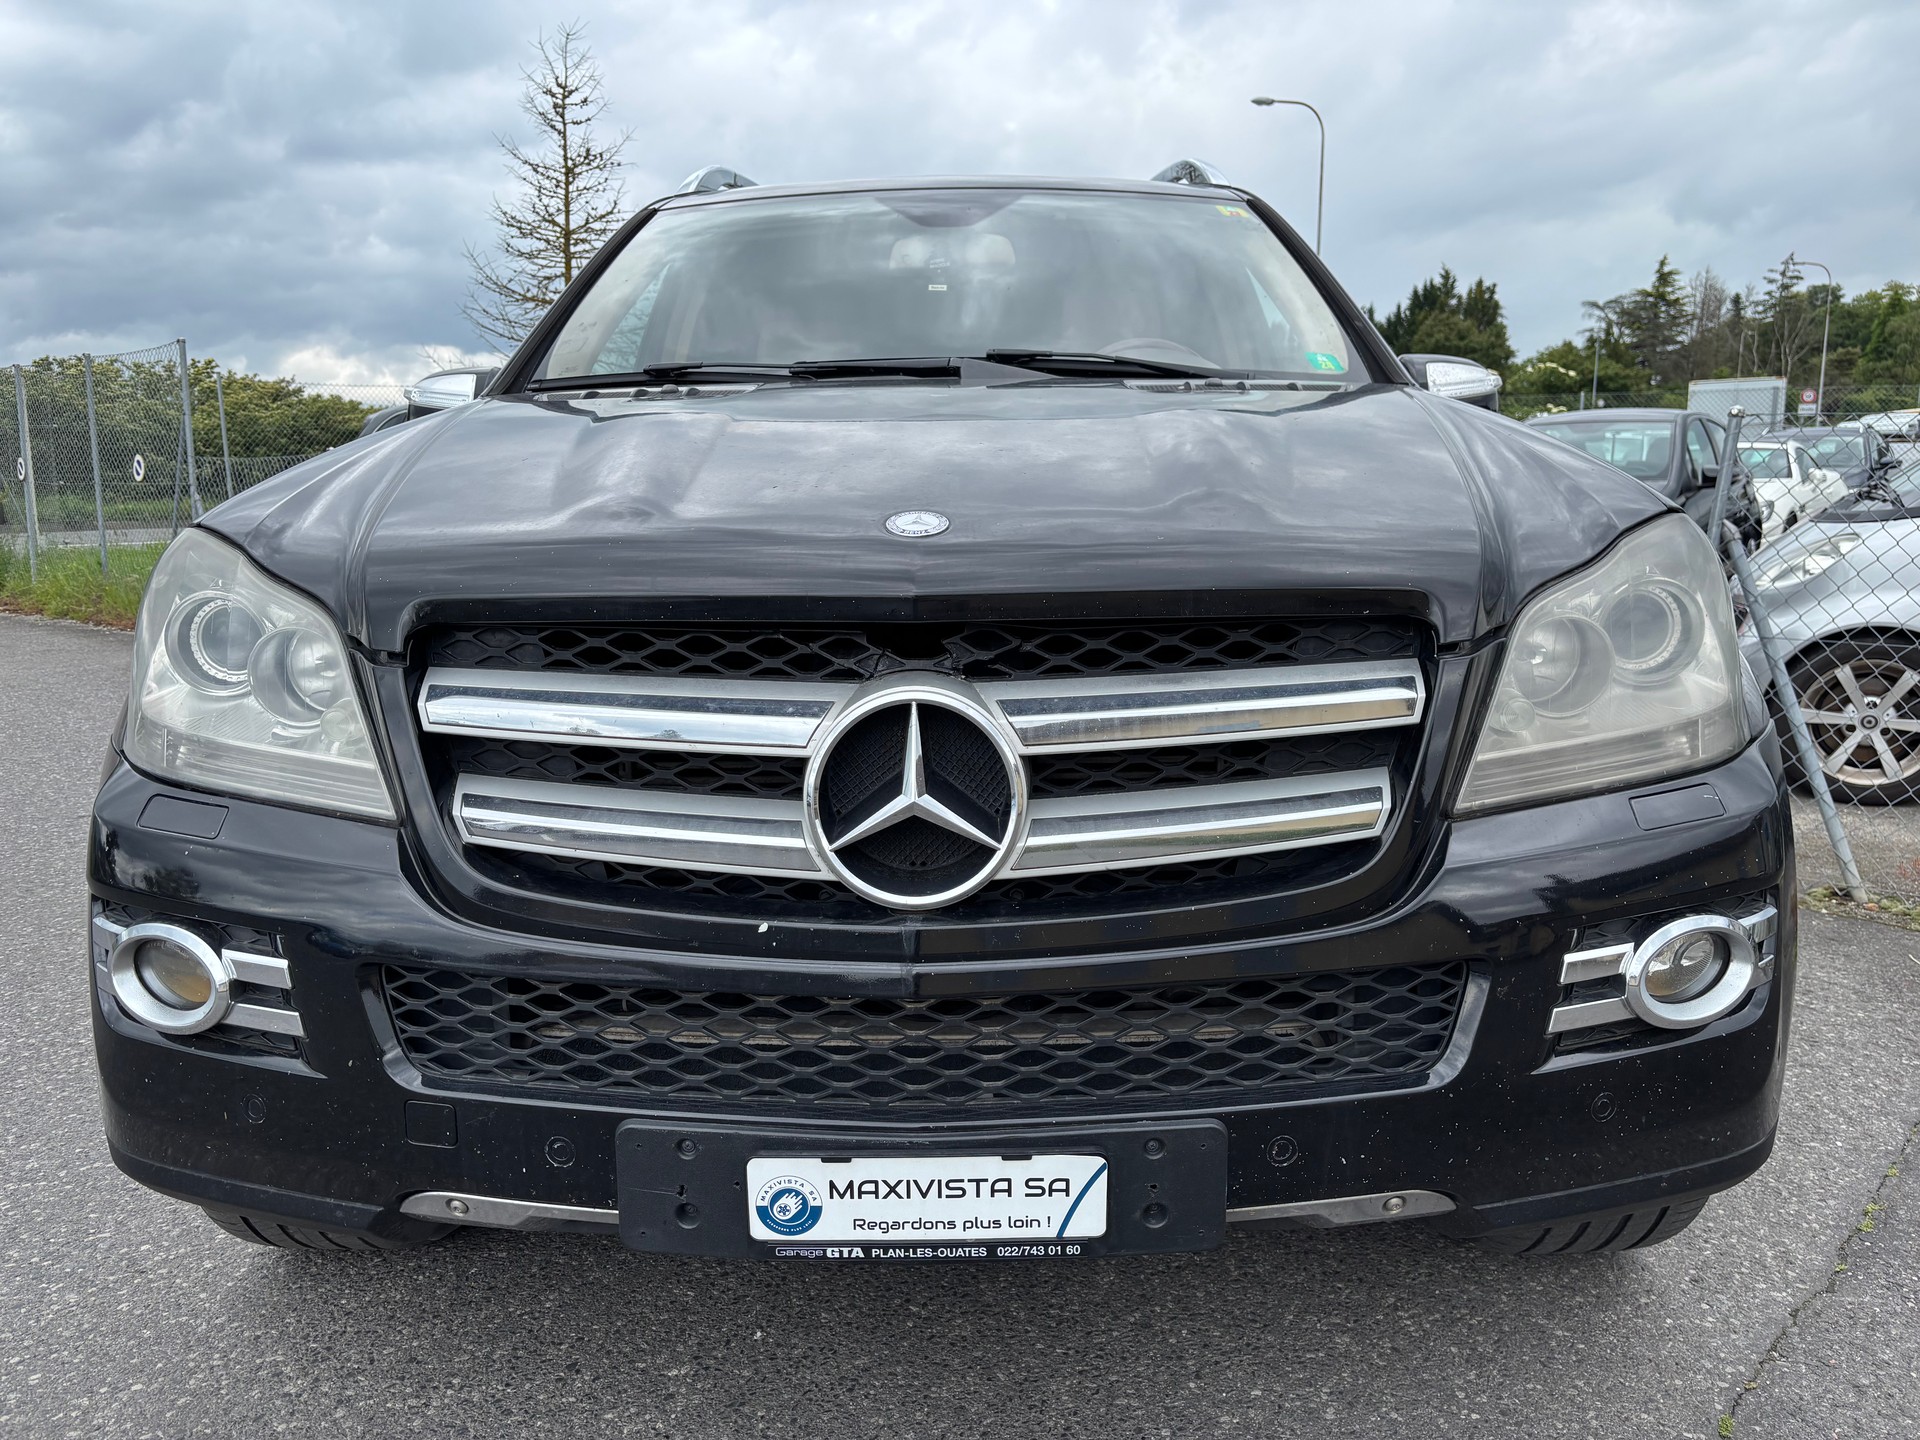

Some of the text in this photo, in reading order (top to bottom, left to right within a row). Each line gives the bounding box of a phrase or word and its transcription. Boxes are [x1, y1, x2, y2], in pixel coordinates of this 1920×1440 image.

[760, 1179, 818, 1202] MAXIVISTA SA
[829, 1178, 1070, 1199] MAXIVISTA SA
[853, 1215, 1052, 1233] Regardons plus loin !
[775, 1245, 1081, 1259] Garage GTA PLAN-LES-OUATES 022/743 01 60
